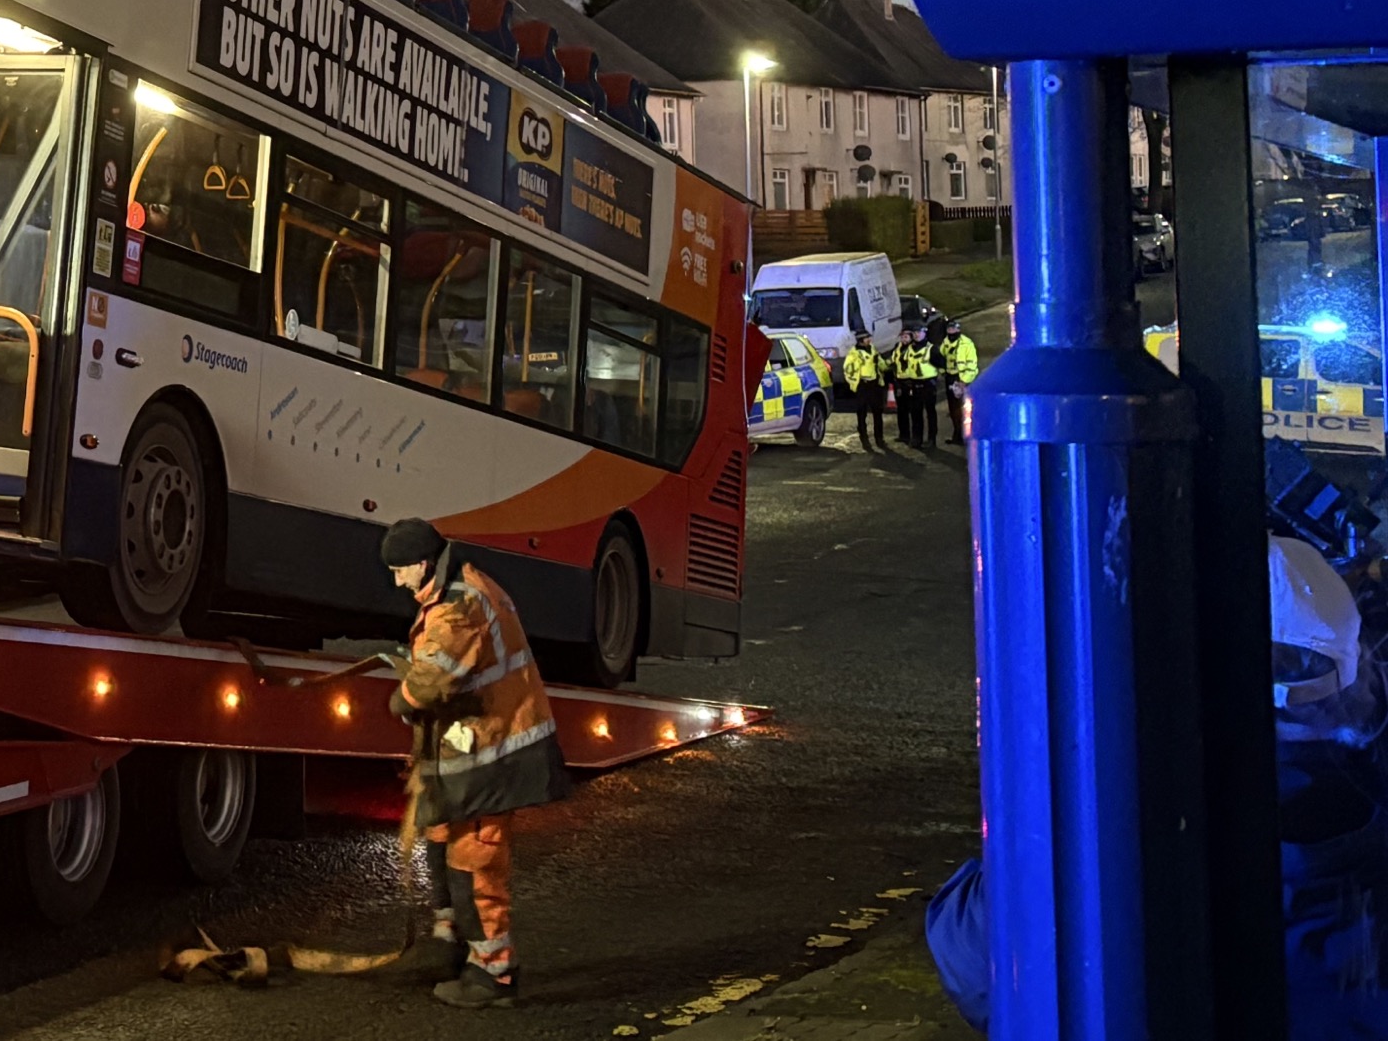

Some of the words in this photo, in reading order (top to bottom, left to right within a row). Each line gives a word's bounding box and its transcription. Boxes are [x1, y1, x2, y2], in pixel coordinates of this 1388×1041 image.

[219, 6, 265, 83] BUT
[266, 31, 296, 97] SO
[298, 45, 320, 109] IS
[324, 58, 412, 156] WALKING
[357, 14, 398, 85] ARE
[398, 37, 493, 142] AVAILABLE,
[521, 114, 551, 153] KP
[517, 167, 549, 199] ORIGINAL
[194, 341, 248, 374] Stagecoach
[1262, 411, 1372, 432] OLICE
